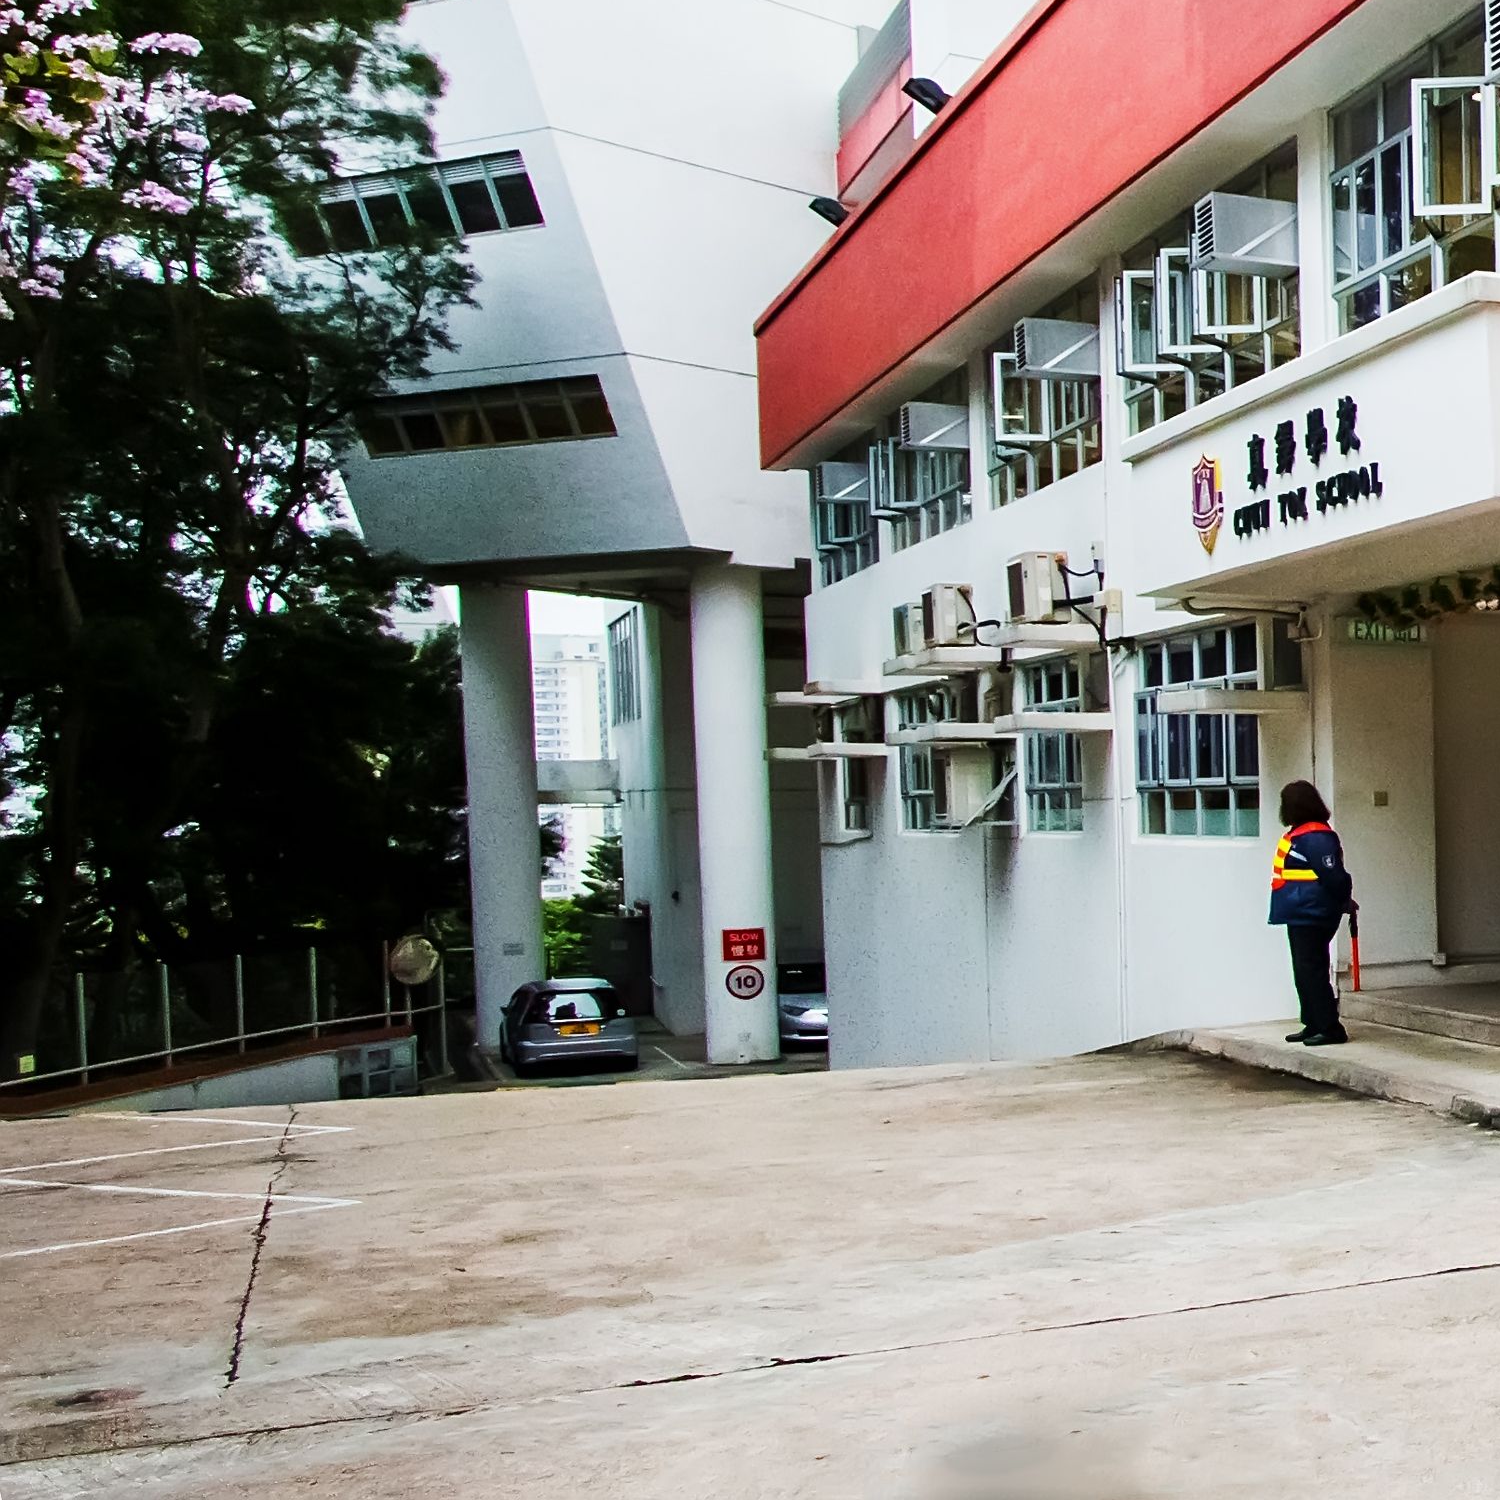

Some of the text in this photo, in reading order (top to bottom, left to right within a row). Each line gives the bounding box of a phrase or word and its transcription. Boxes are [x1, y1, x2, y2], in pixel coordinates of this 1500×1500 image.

[1315, 462, 1383, 514] SCHOOL
[729, 933, 759, 941] SLOW
[735, 975, 756, 989] 10
